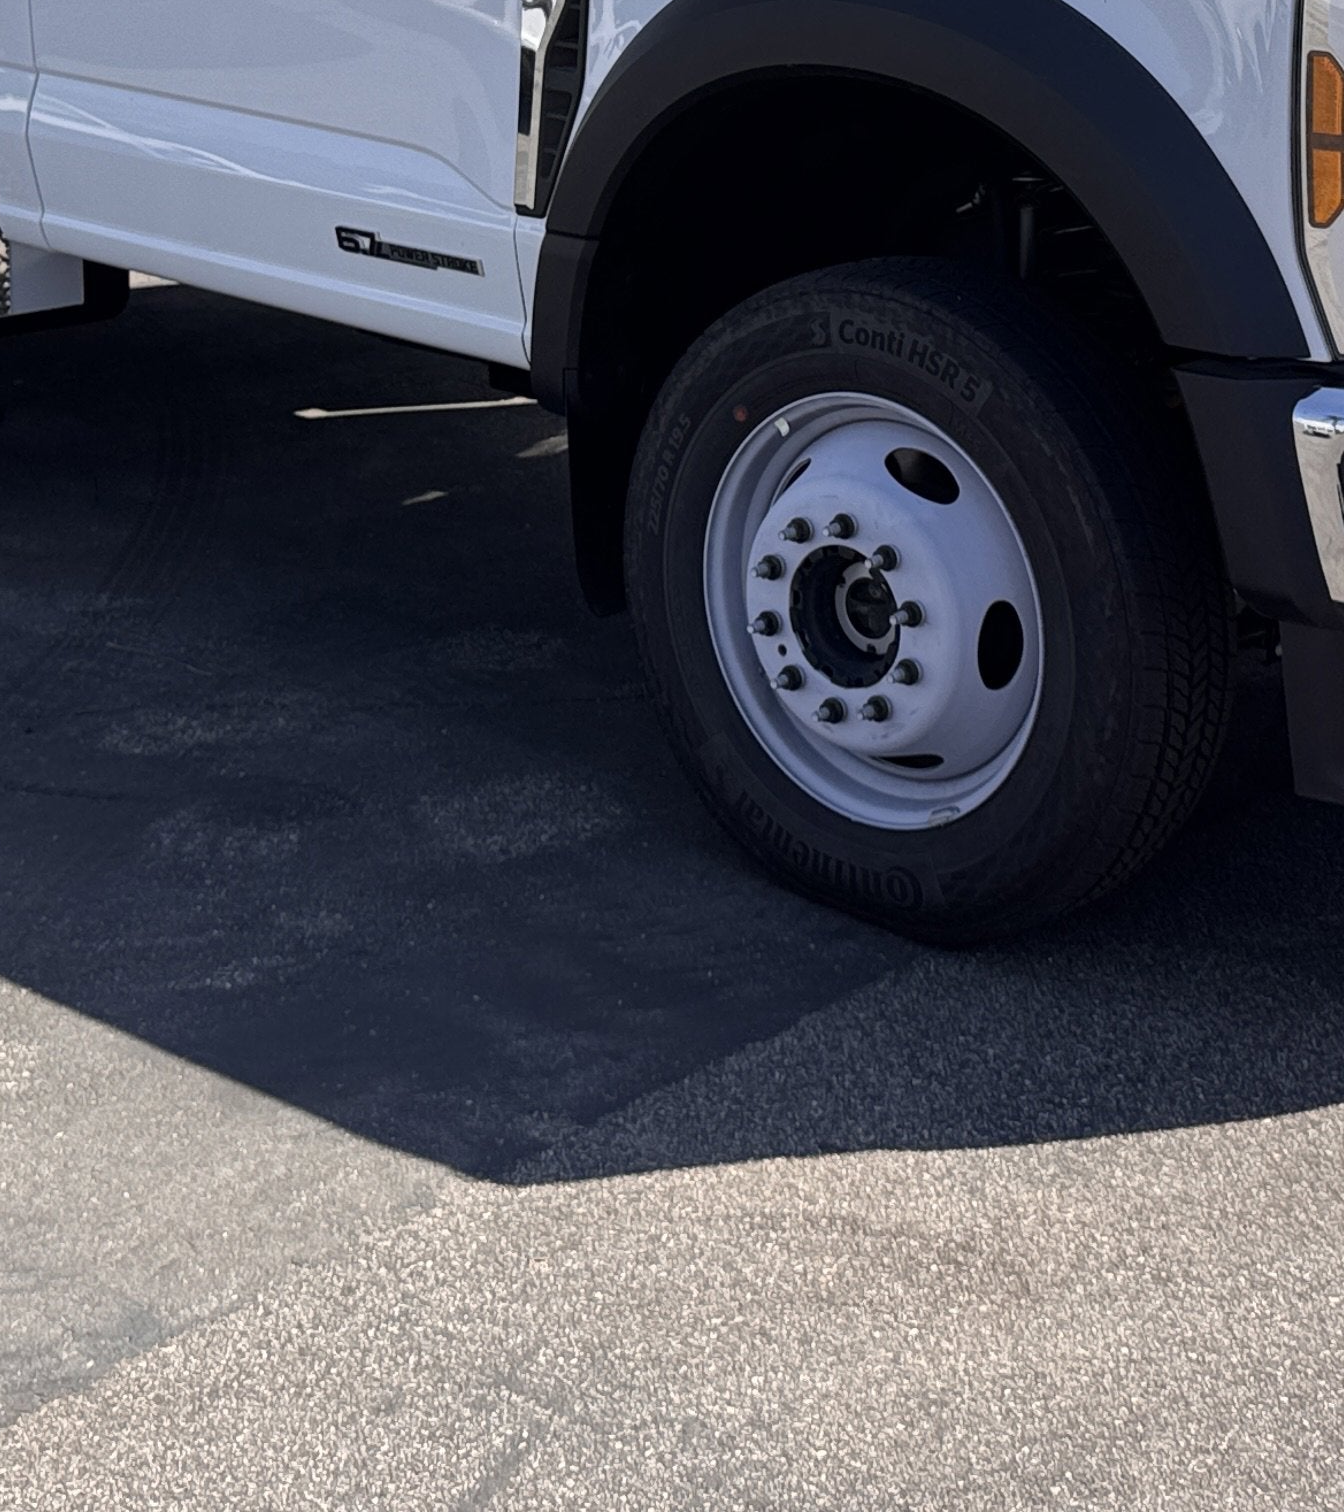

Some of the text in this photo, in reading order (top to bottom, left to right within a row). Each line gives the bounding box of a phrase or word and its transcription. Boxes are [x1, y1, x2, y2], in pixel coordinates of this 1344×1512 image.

[838, 318, 982, 403] Conti HSR 5
